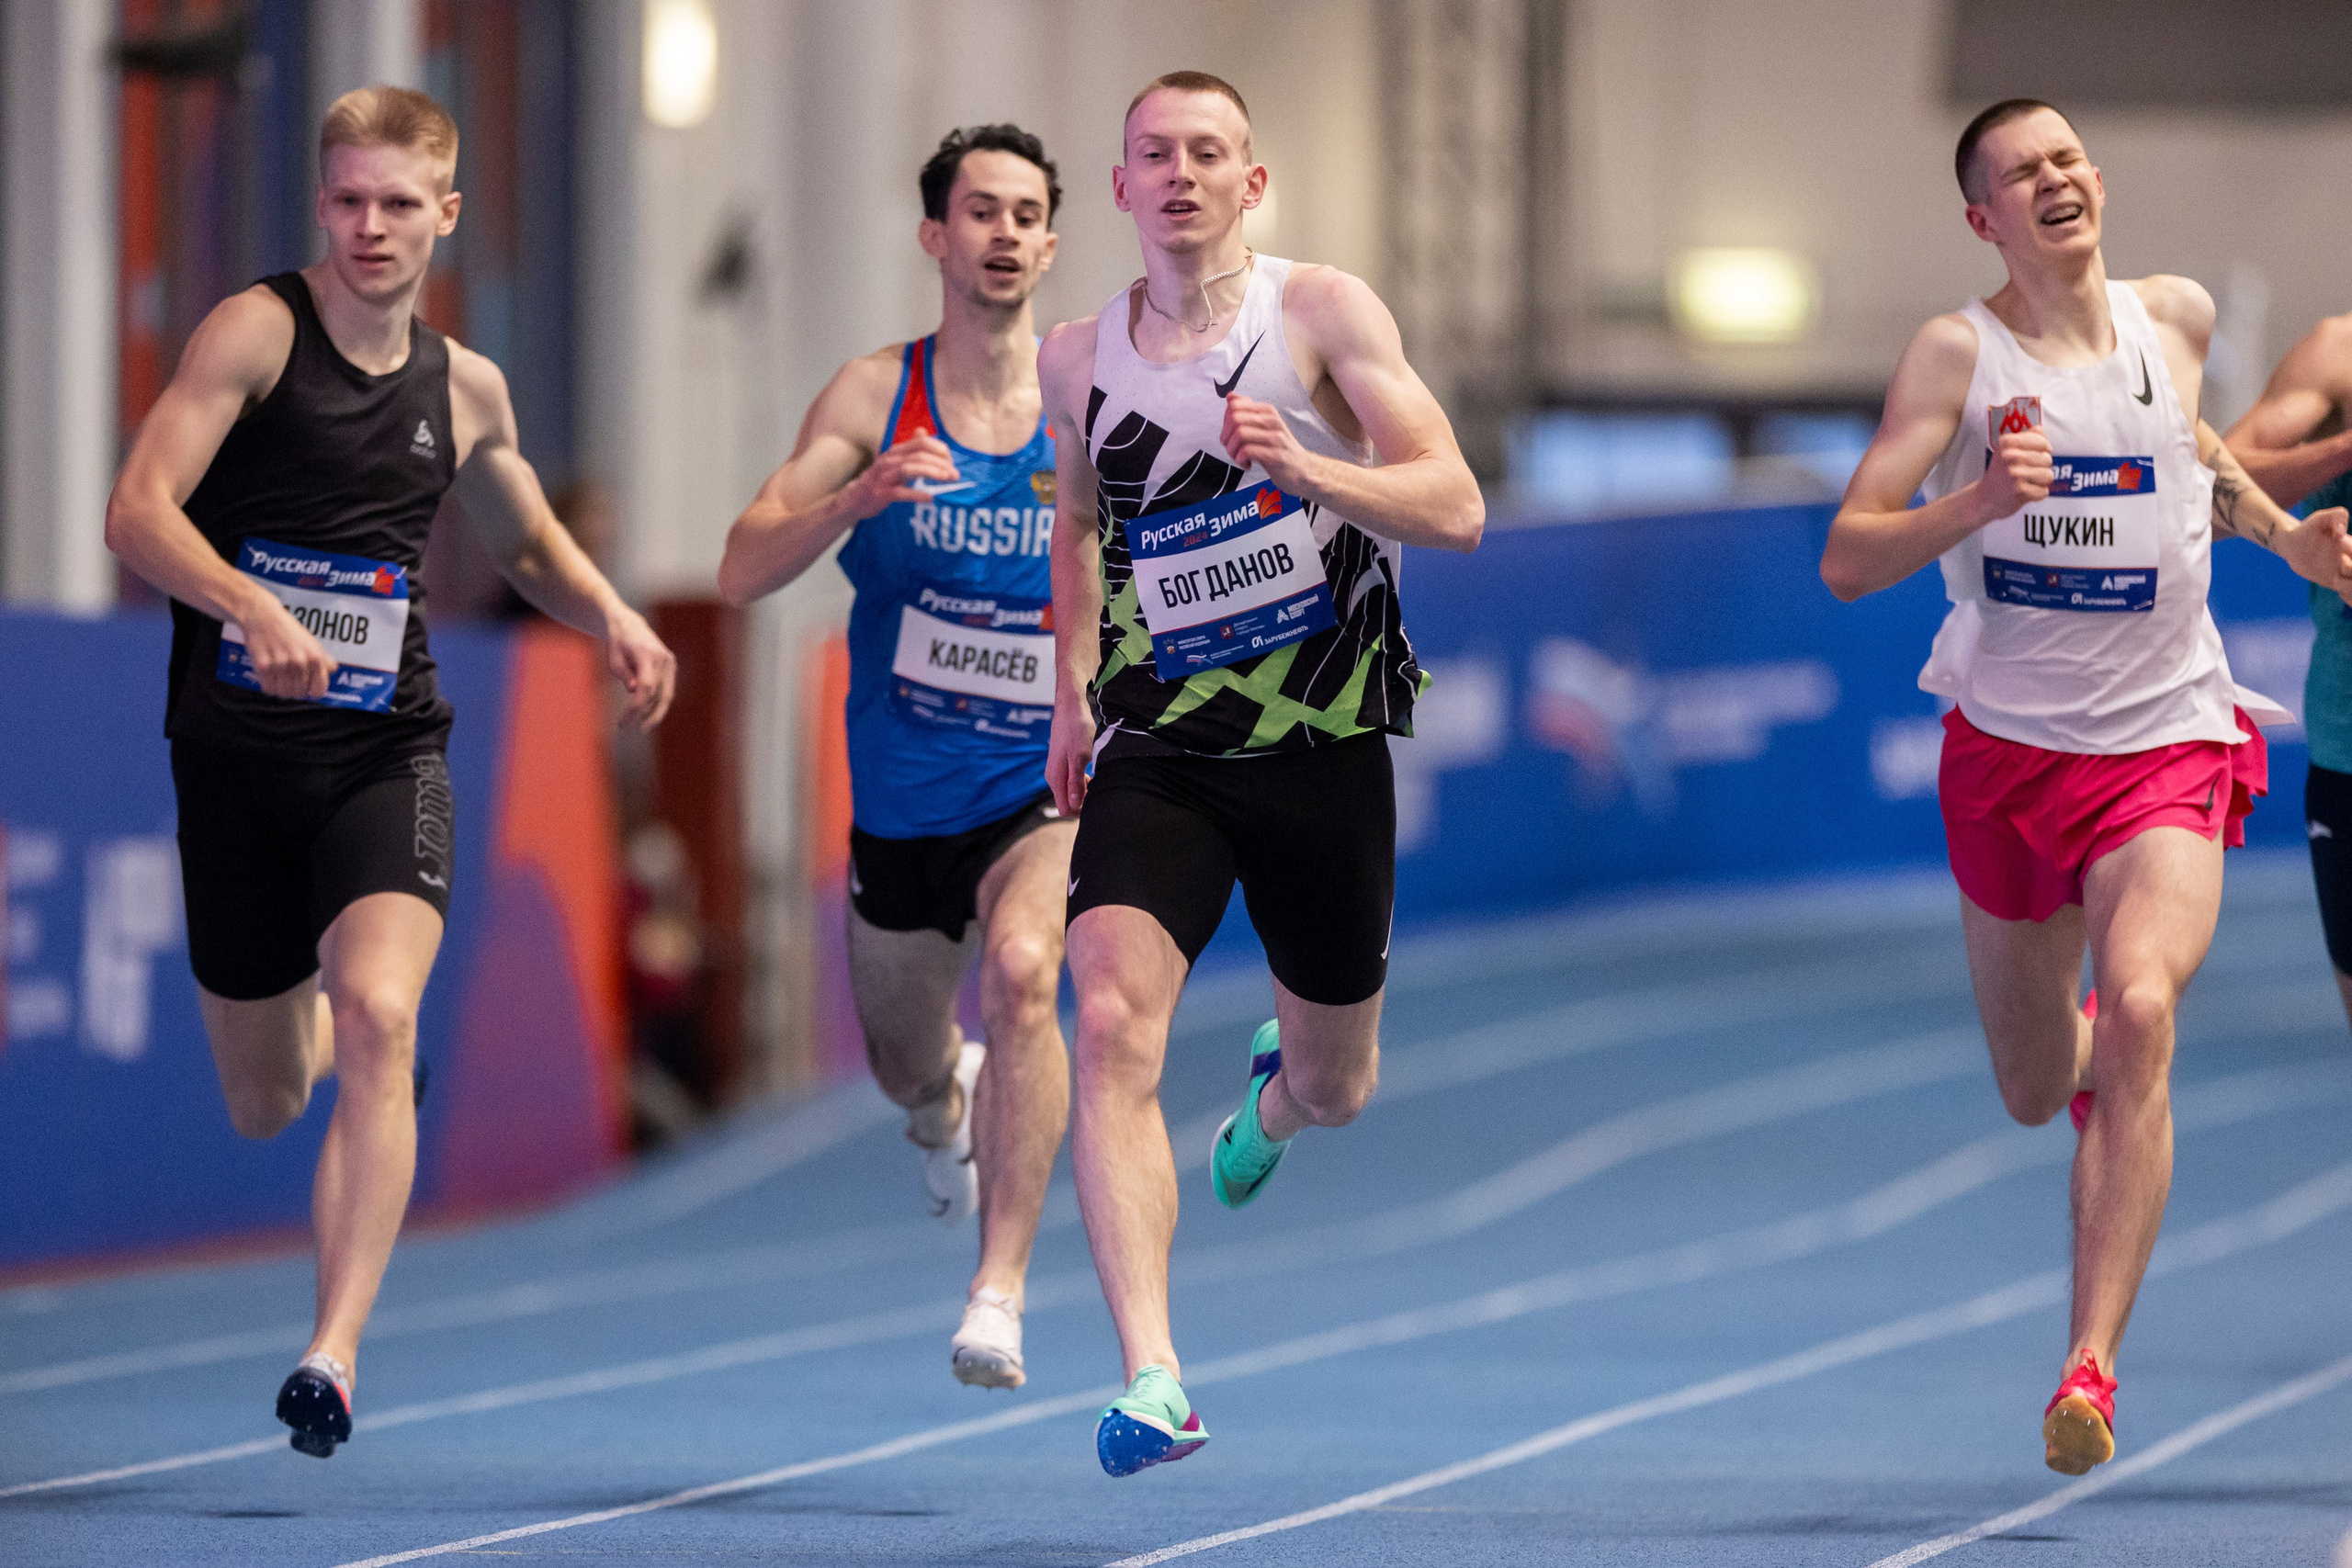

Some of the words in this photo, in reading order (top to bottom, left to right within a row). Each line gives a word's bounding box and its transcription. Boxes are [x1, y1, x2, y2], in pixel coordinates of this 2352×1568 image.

[913, 502, 1056, 557] RUSSIA
[1141, 512, 1206, 551] Русская
[1208, 501, 1260, 537] Зима
[1183, 531, 1208, 548] 2024
[2024, 513, 2113, 548] ЩУКИН
[251, 550, 332, 575] Русская
[324, 570, 377, 588] Зима
[1158, 543, 1295, 609] БОГДАНОВ
[928, 638, 1039, 683] КАРАСЁВ
